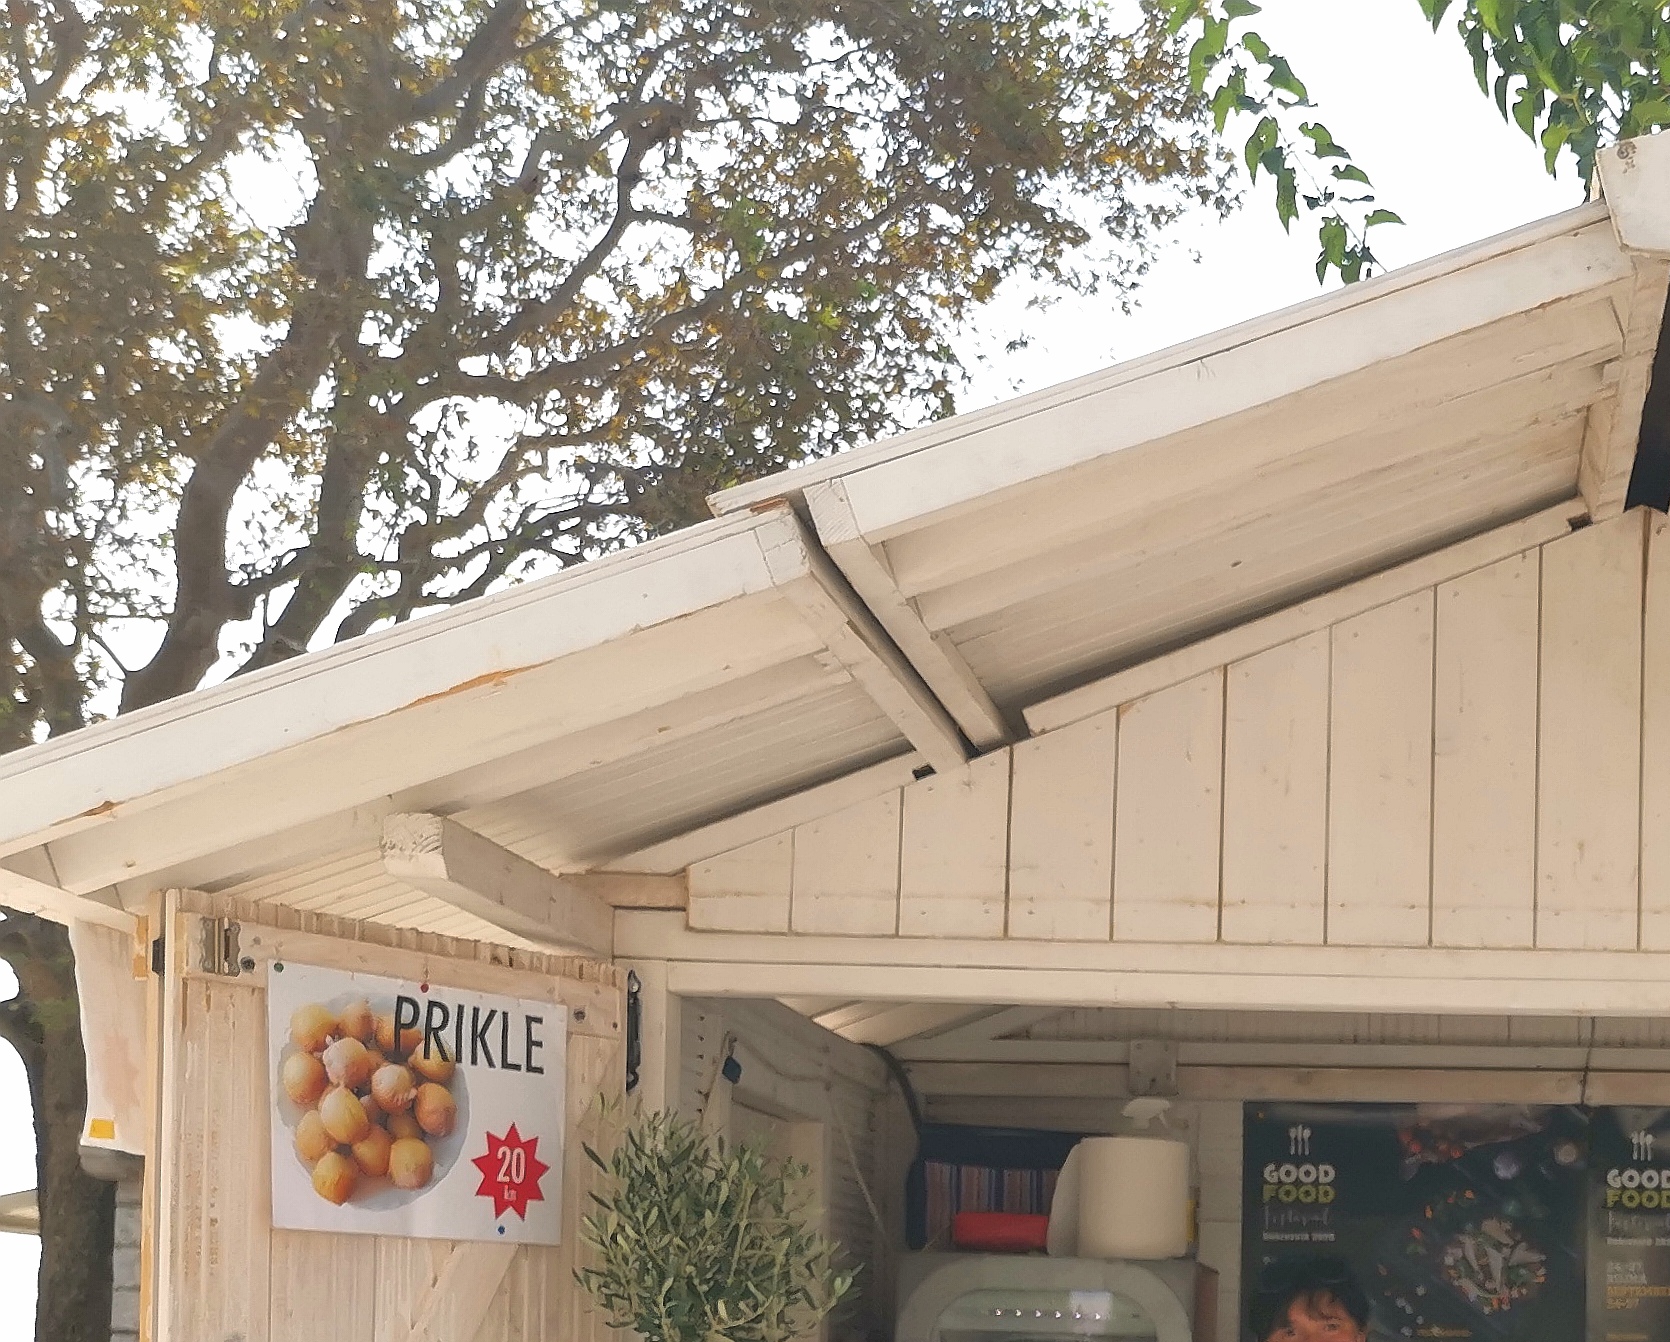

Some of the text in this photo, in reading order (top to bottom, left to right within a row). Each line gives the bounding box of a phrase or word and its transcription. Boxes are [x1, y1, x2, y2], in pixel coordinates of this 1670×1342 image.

[394, 995, 545, 1074] PRIKLE
[496, 1146, 525, 1184] 20
[1263, 1163, 1336, 1184] GOOD
[1263, 1184, 1337, 1205] FOOD
